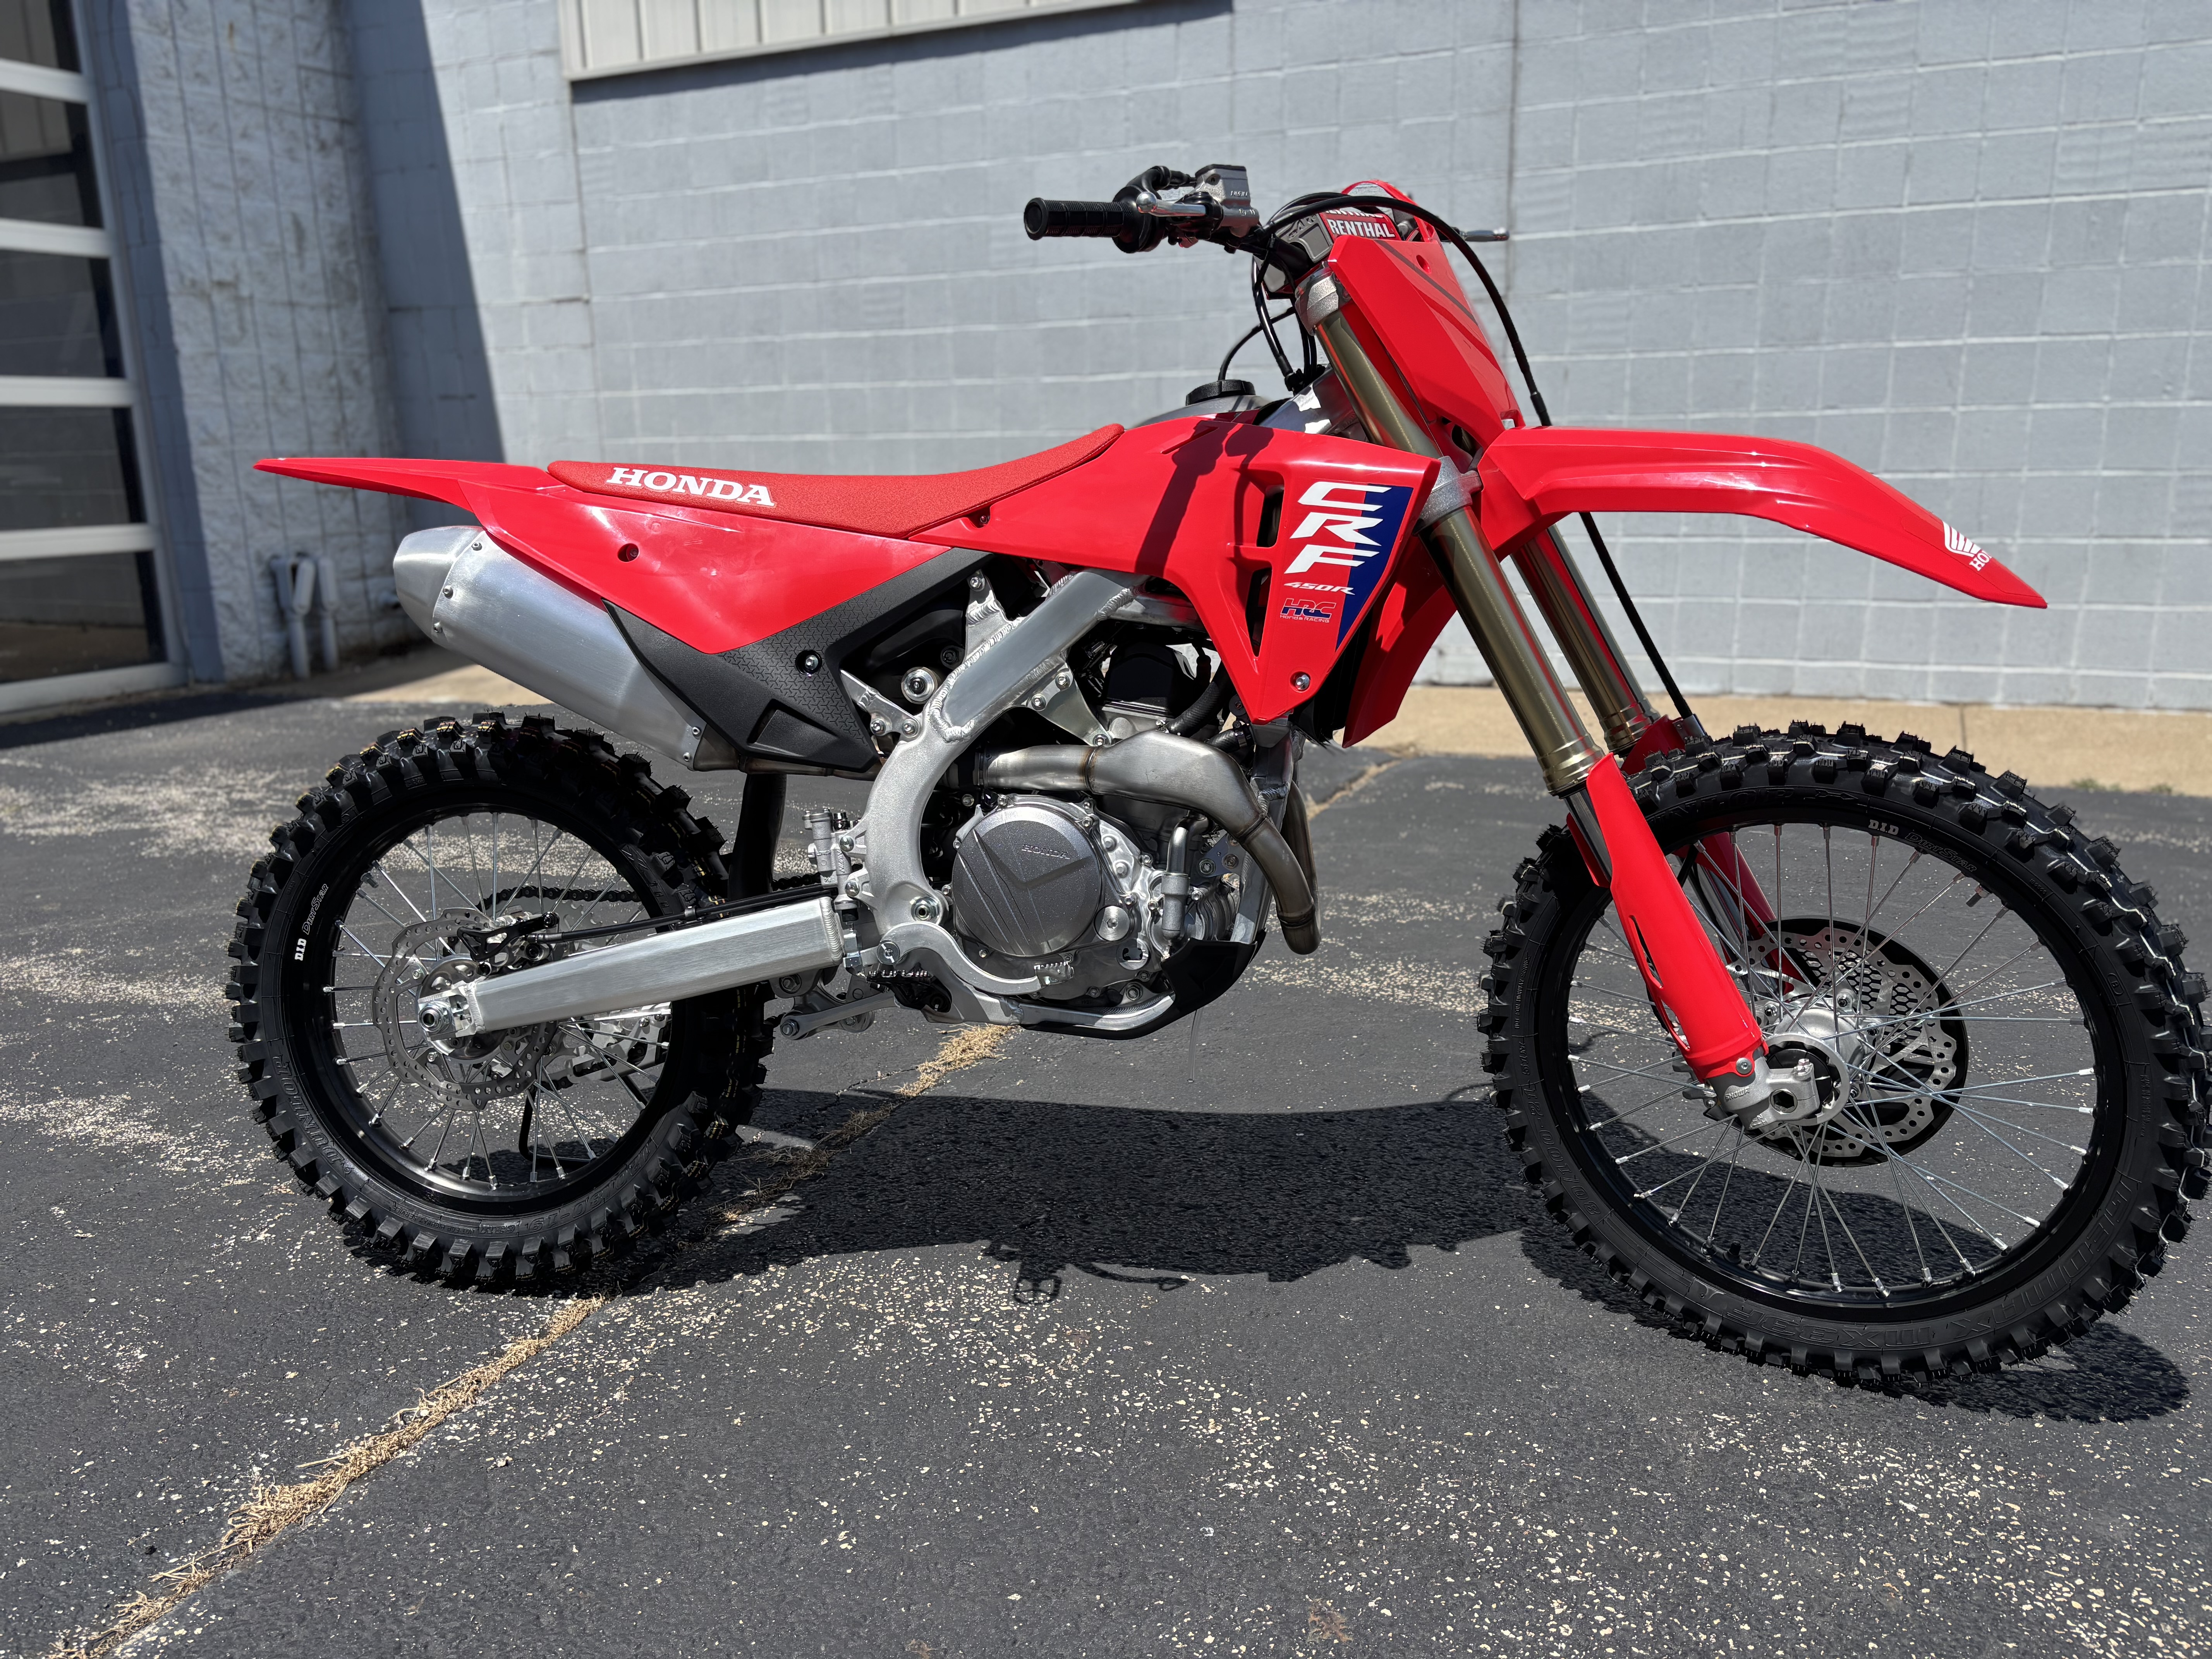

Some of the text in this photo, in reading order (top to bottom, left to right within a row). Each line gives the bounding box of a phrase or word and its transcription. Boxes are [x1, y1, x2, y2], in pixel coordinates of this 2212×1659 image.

[1327, 219, 1395, 237] RENTHAL
[606, 467, 775, 506] HONDA
[1284, 481, 1391, 574] CRF
[1284, 582, 1355, 595] 450R
[1280, 598, 1336, 619] HRC
[1022, 844, 1070, 859] HONDA
[272, 1054, 345, 1164] DUNLOP
